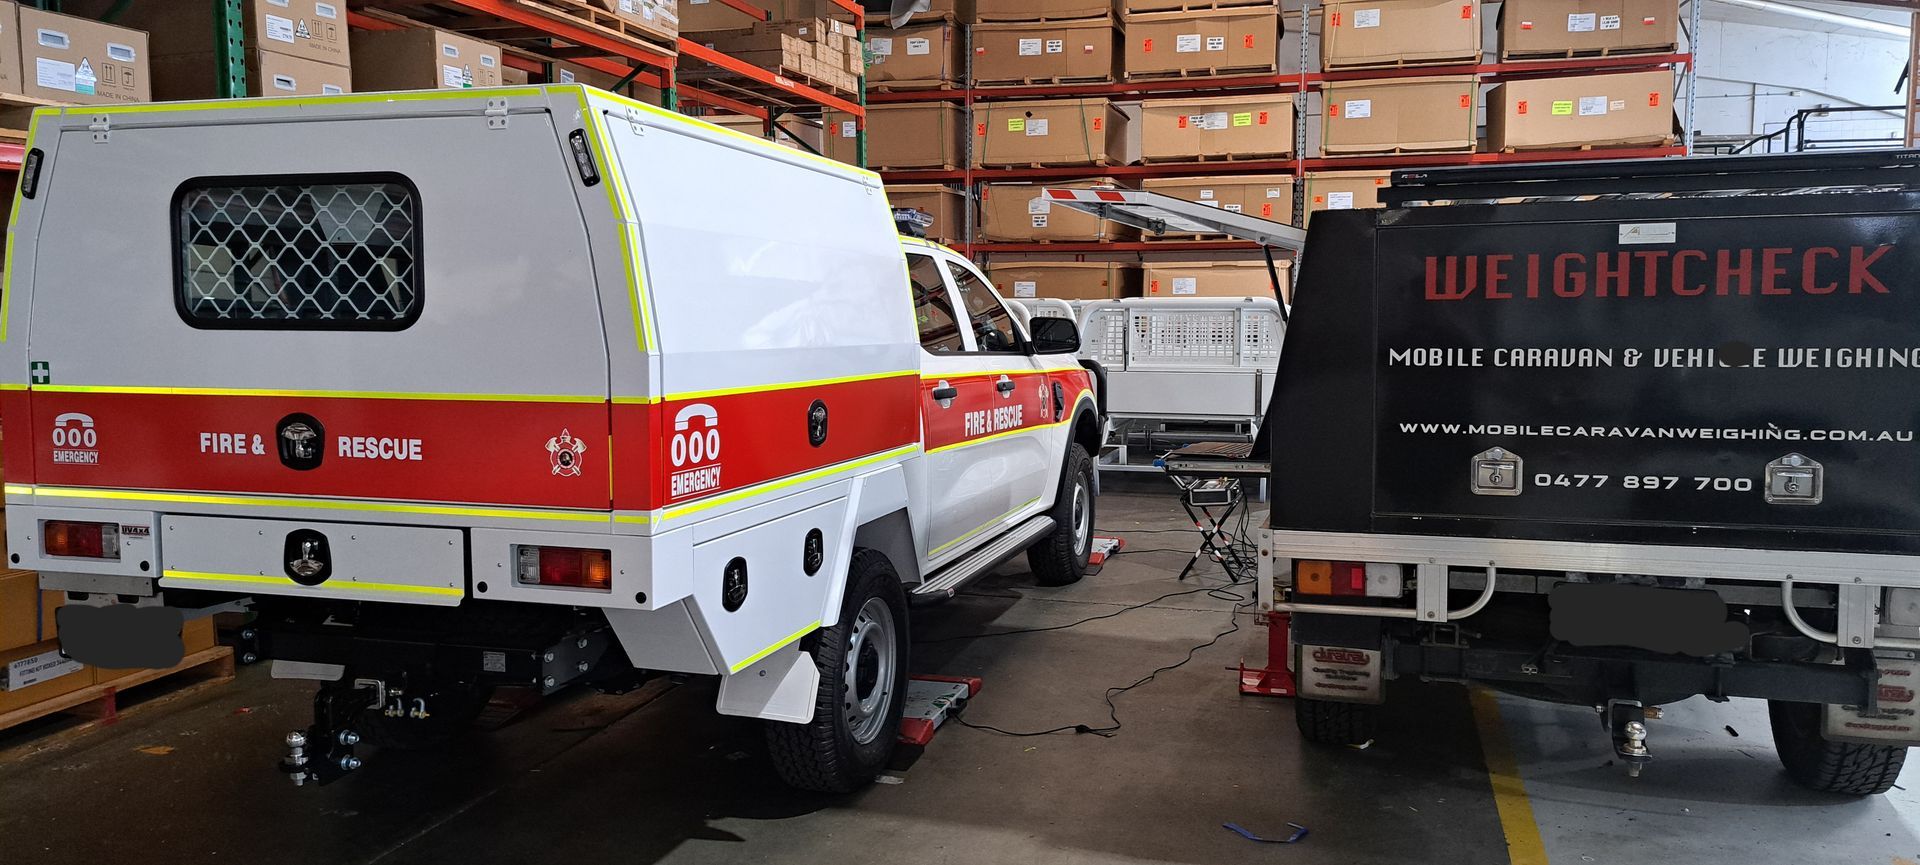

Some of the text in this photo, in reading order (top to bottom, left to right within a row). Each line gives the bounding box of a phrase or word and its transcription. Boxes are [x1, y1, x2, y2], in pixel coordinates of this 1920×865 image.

[97, 91, 115, 100] MADE
[123, 94, 140, 102] CHINA
[1425, 245, 1895, 300] WEIGHTCHECK
[1389, 348, 1484, 367] MOBILE
[1494, 348, 1613, 367] CARAVAN
[1624, 348, 1643, 367] &
[1654, 348, 1767, 368] VEHIE
[965, 404, 1023, 437] FIRE & RESCUE
[53, 427, 97, 448] 000
[1400, 423, 1913, 442] WWW.MOBILECARAVANWEIGHING.COM.AU
[54, 450, 99, 463] EMERGENCY
[200, 432, 423, 461] FIRE & RESCUE
[671, 429, 720, 467] 000
[671, 466, 721, 497] EMERGENCY
[1534, 473, 1752, 491] 0477 897 700
